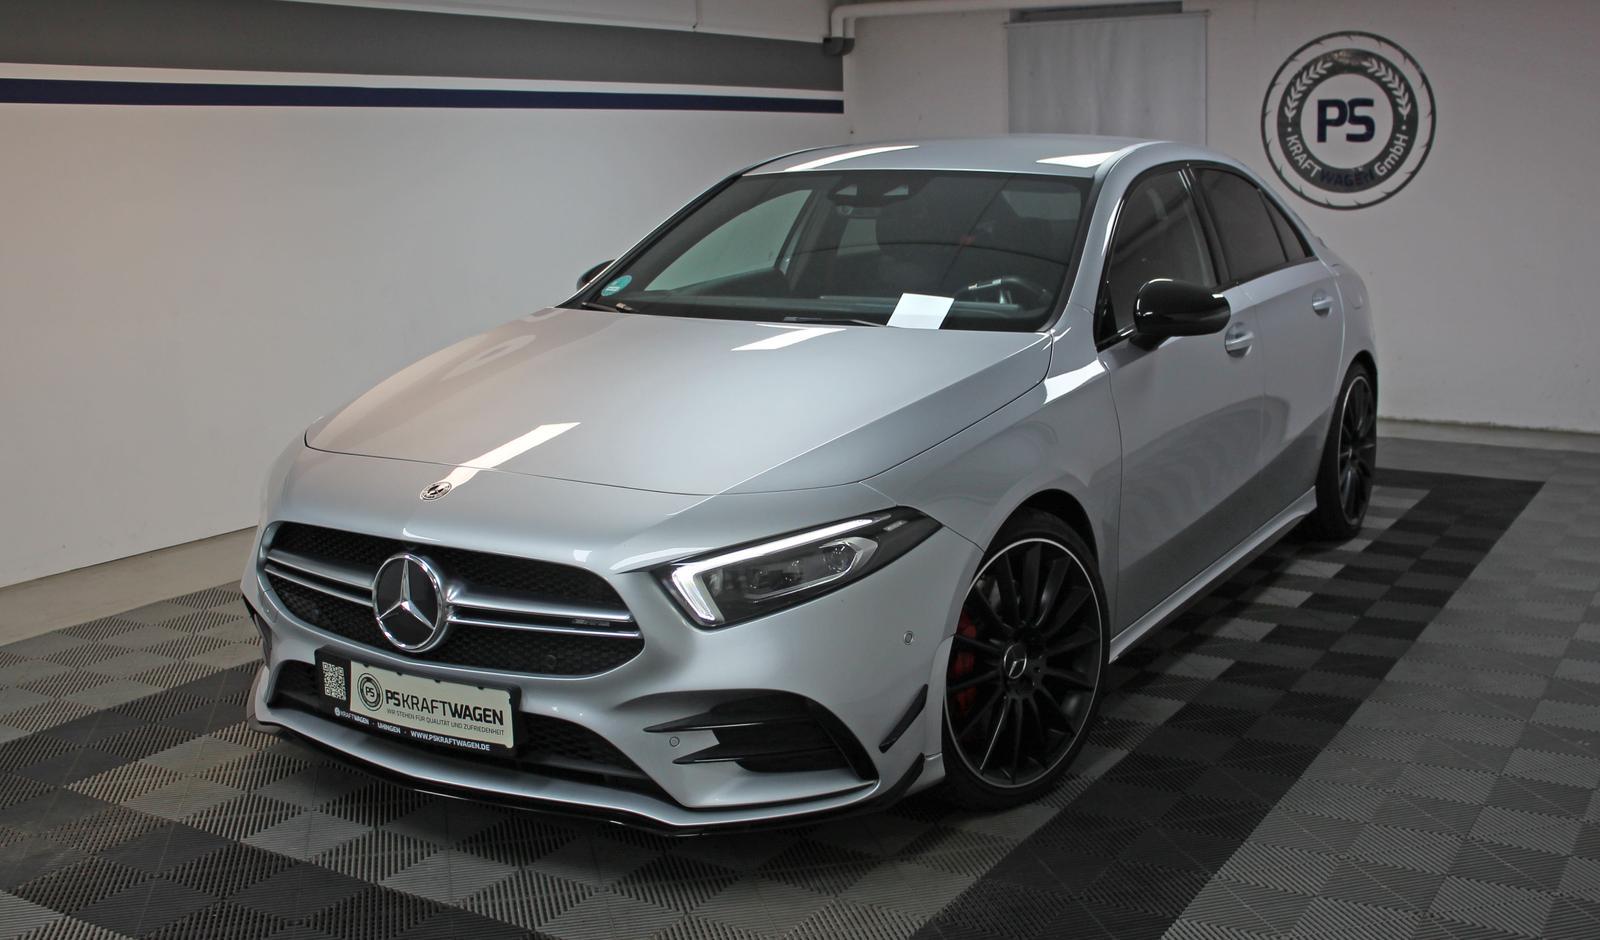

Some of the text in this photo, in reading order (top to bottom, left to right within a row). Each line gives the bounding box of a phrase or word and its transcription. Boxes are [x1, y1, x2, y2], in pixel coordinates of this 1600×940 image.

[1316, 97, 1376, 143] PS
[1375, 134, 1408, 177] GmbH
[365, 686, 375, 698] PS
[396, 710, 415, 720] STEHEN
[450, 721, 463, 729] UND
[463, 723, 505, 736] ZUFRIEDENHEIT
[410, 730, 491, 751] WWW.PSKRAFTWAGEN.DE
